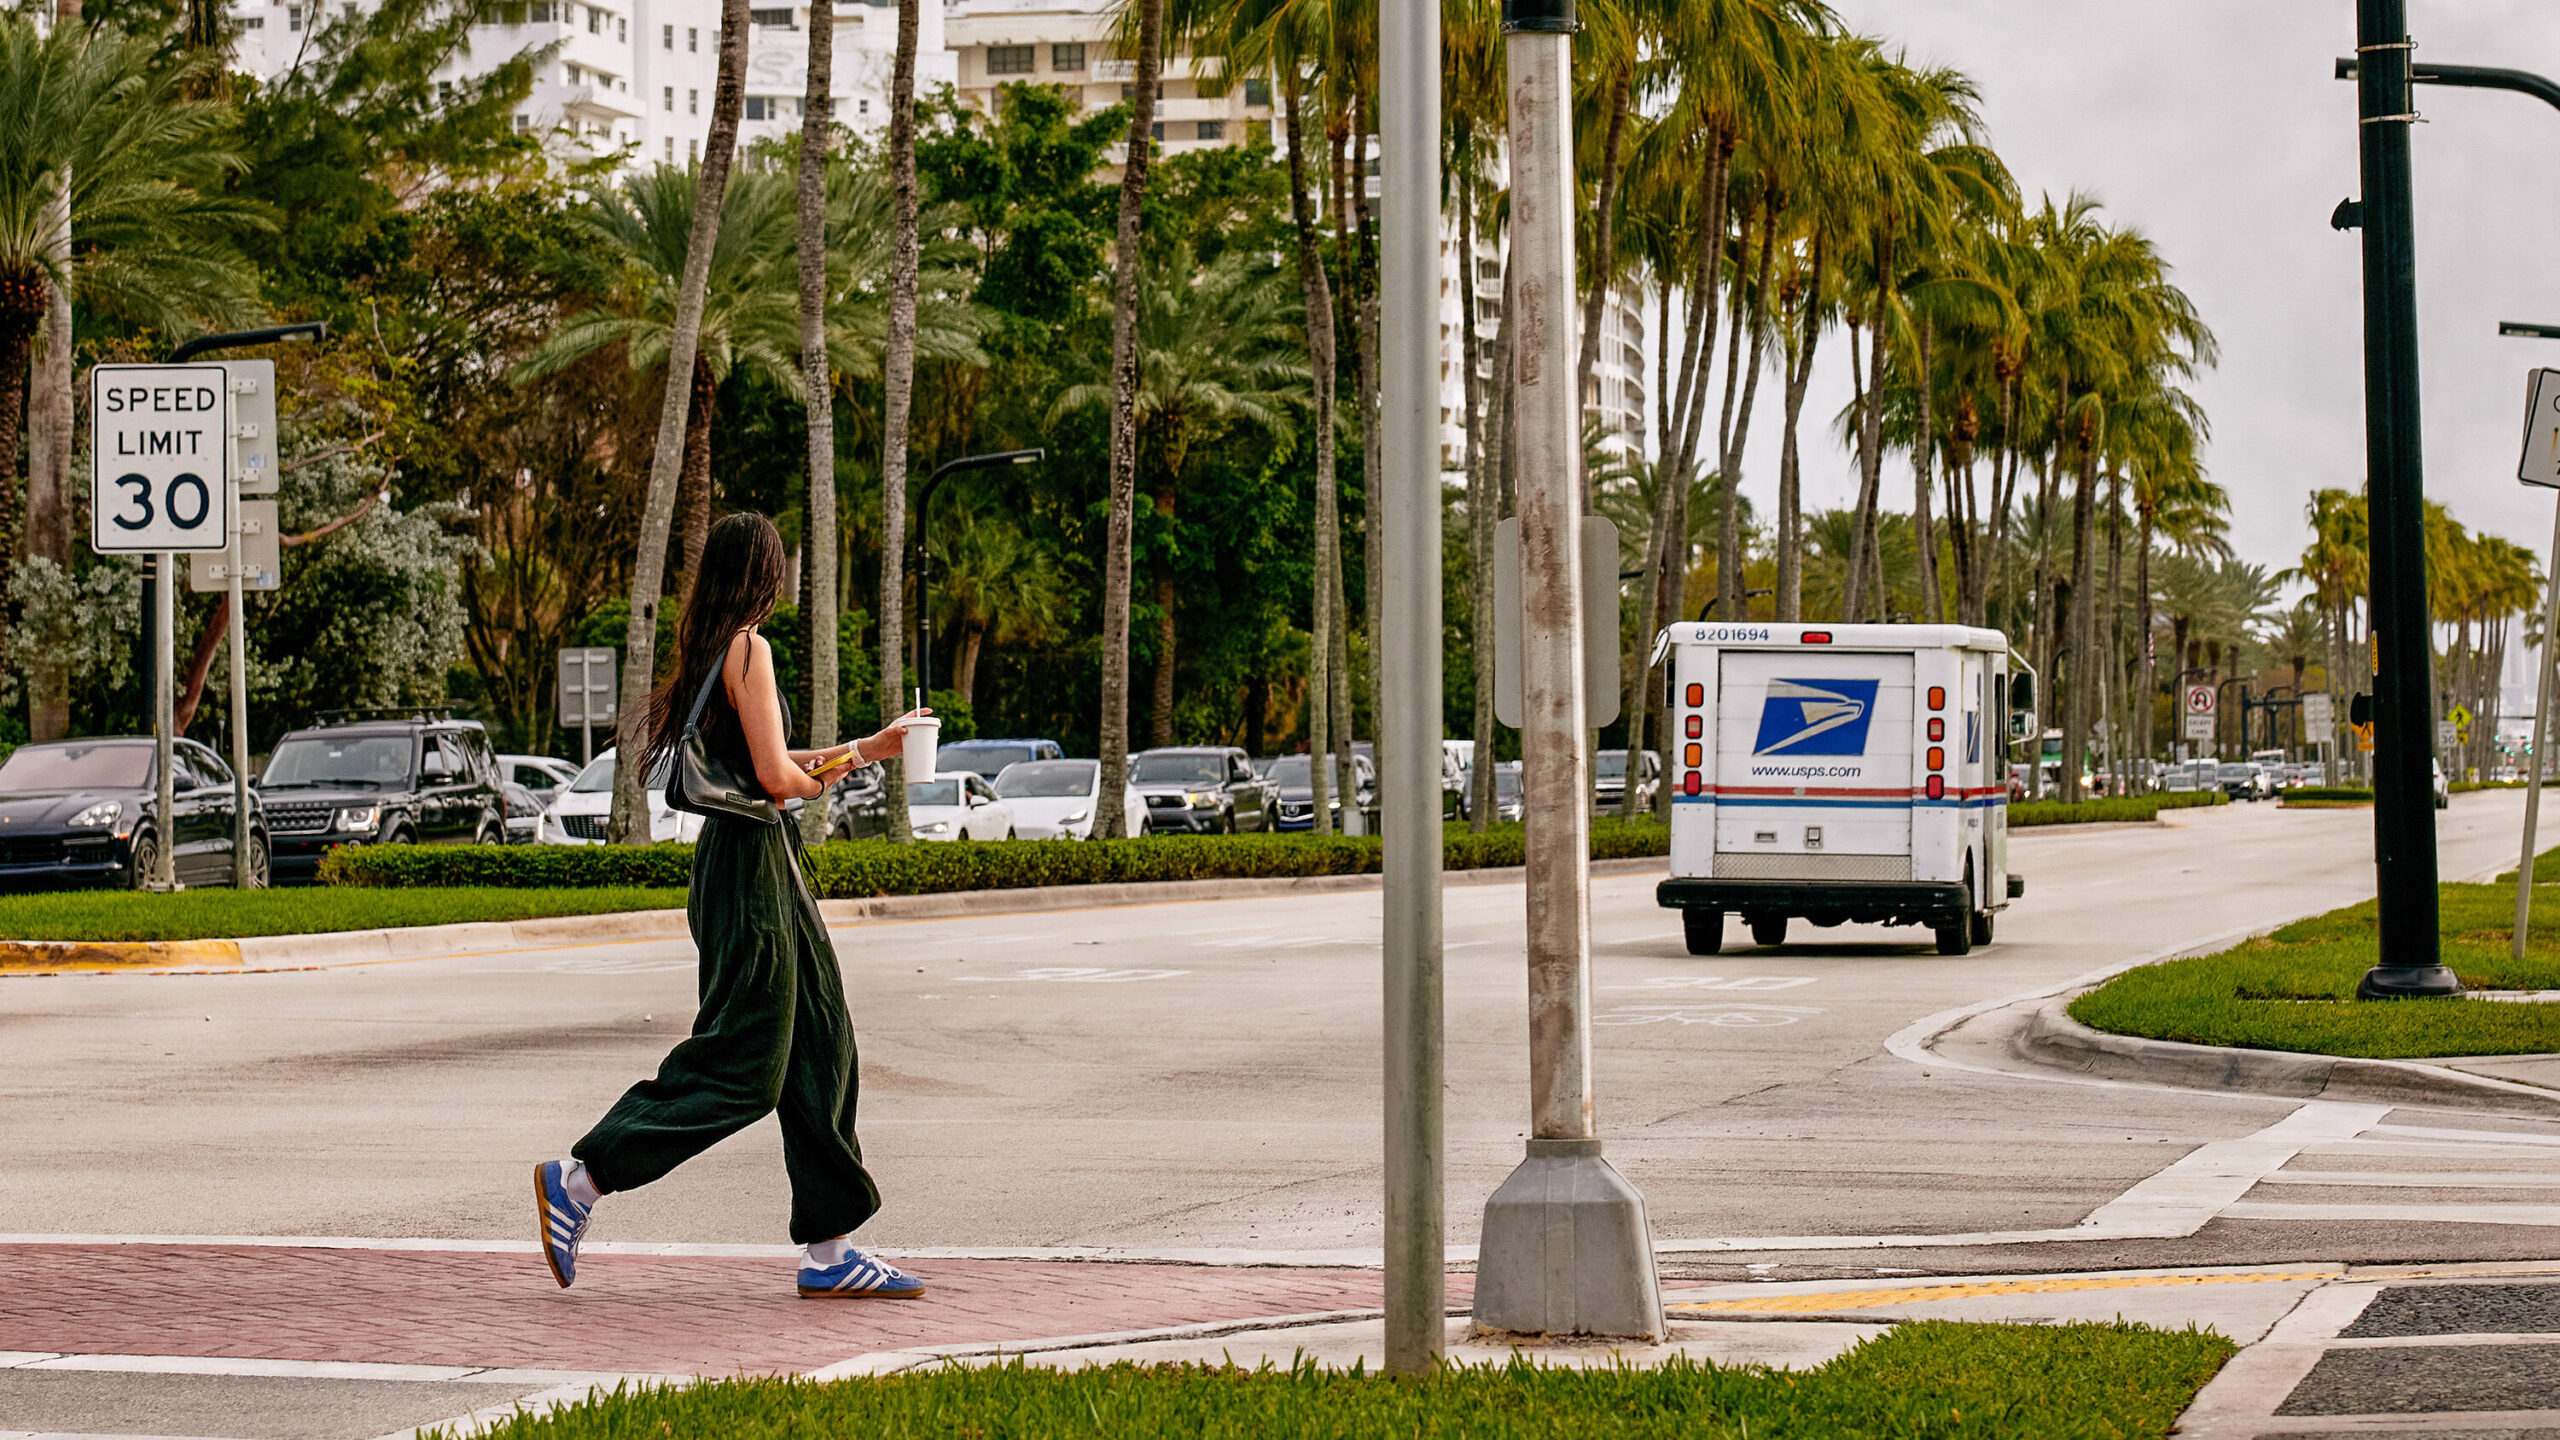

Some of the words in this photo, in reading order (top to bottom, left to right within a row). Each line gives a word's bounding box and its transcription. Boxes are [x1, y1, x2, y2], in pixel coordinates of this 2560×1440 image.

[107, 387, 216, 412] SPEED
[118, 431, 203, 455] LIMIT
[112, 473, 210, 530] 30
[1695, 628, 1769, 641] 8201694
[1751, 766, 1861, 779] www.usps.com
[951, 967, 1193, 983] 30
[1598, 976, 1820, 990] 30
